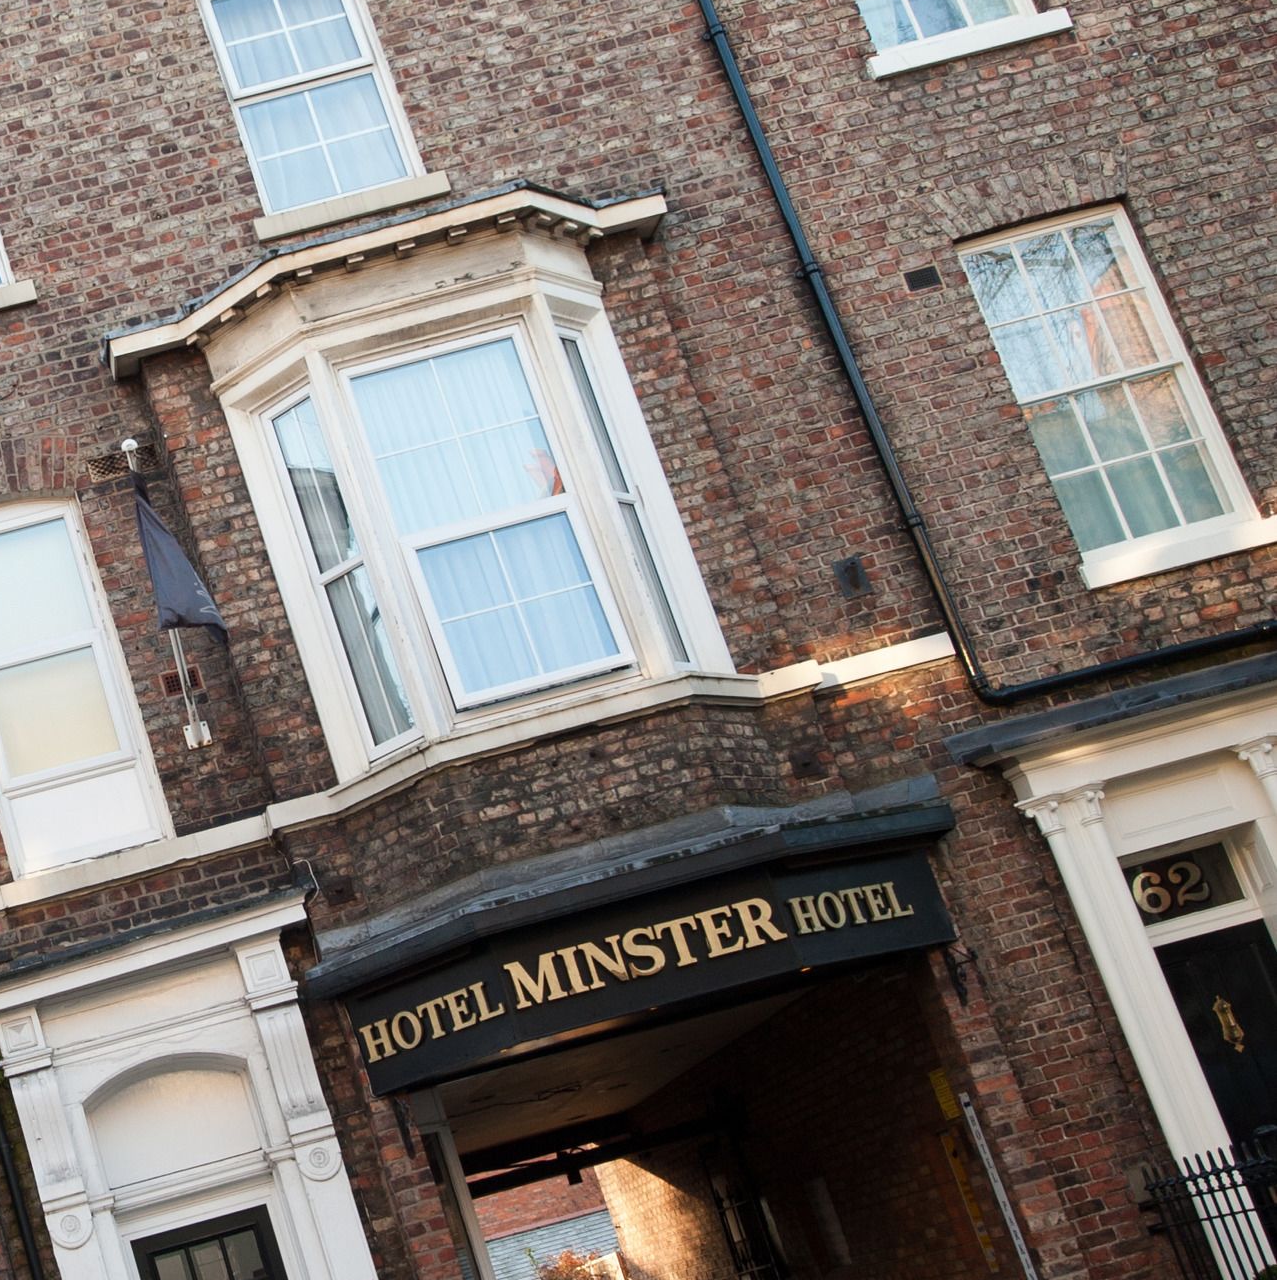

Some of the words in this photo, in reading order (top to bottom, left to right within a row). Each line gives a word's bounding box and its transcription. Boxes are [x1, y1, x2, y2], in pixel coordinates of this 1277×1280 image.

[1131, 860, 1211, 914] 62
[358, 981, 505, 1064] HOTEL
[503, 897, 788, 1010] MINSTER
[787, 881, 915, 935] HOTEL
